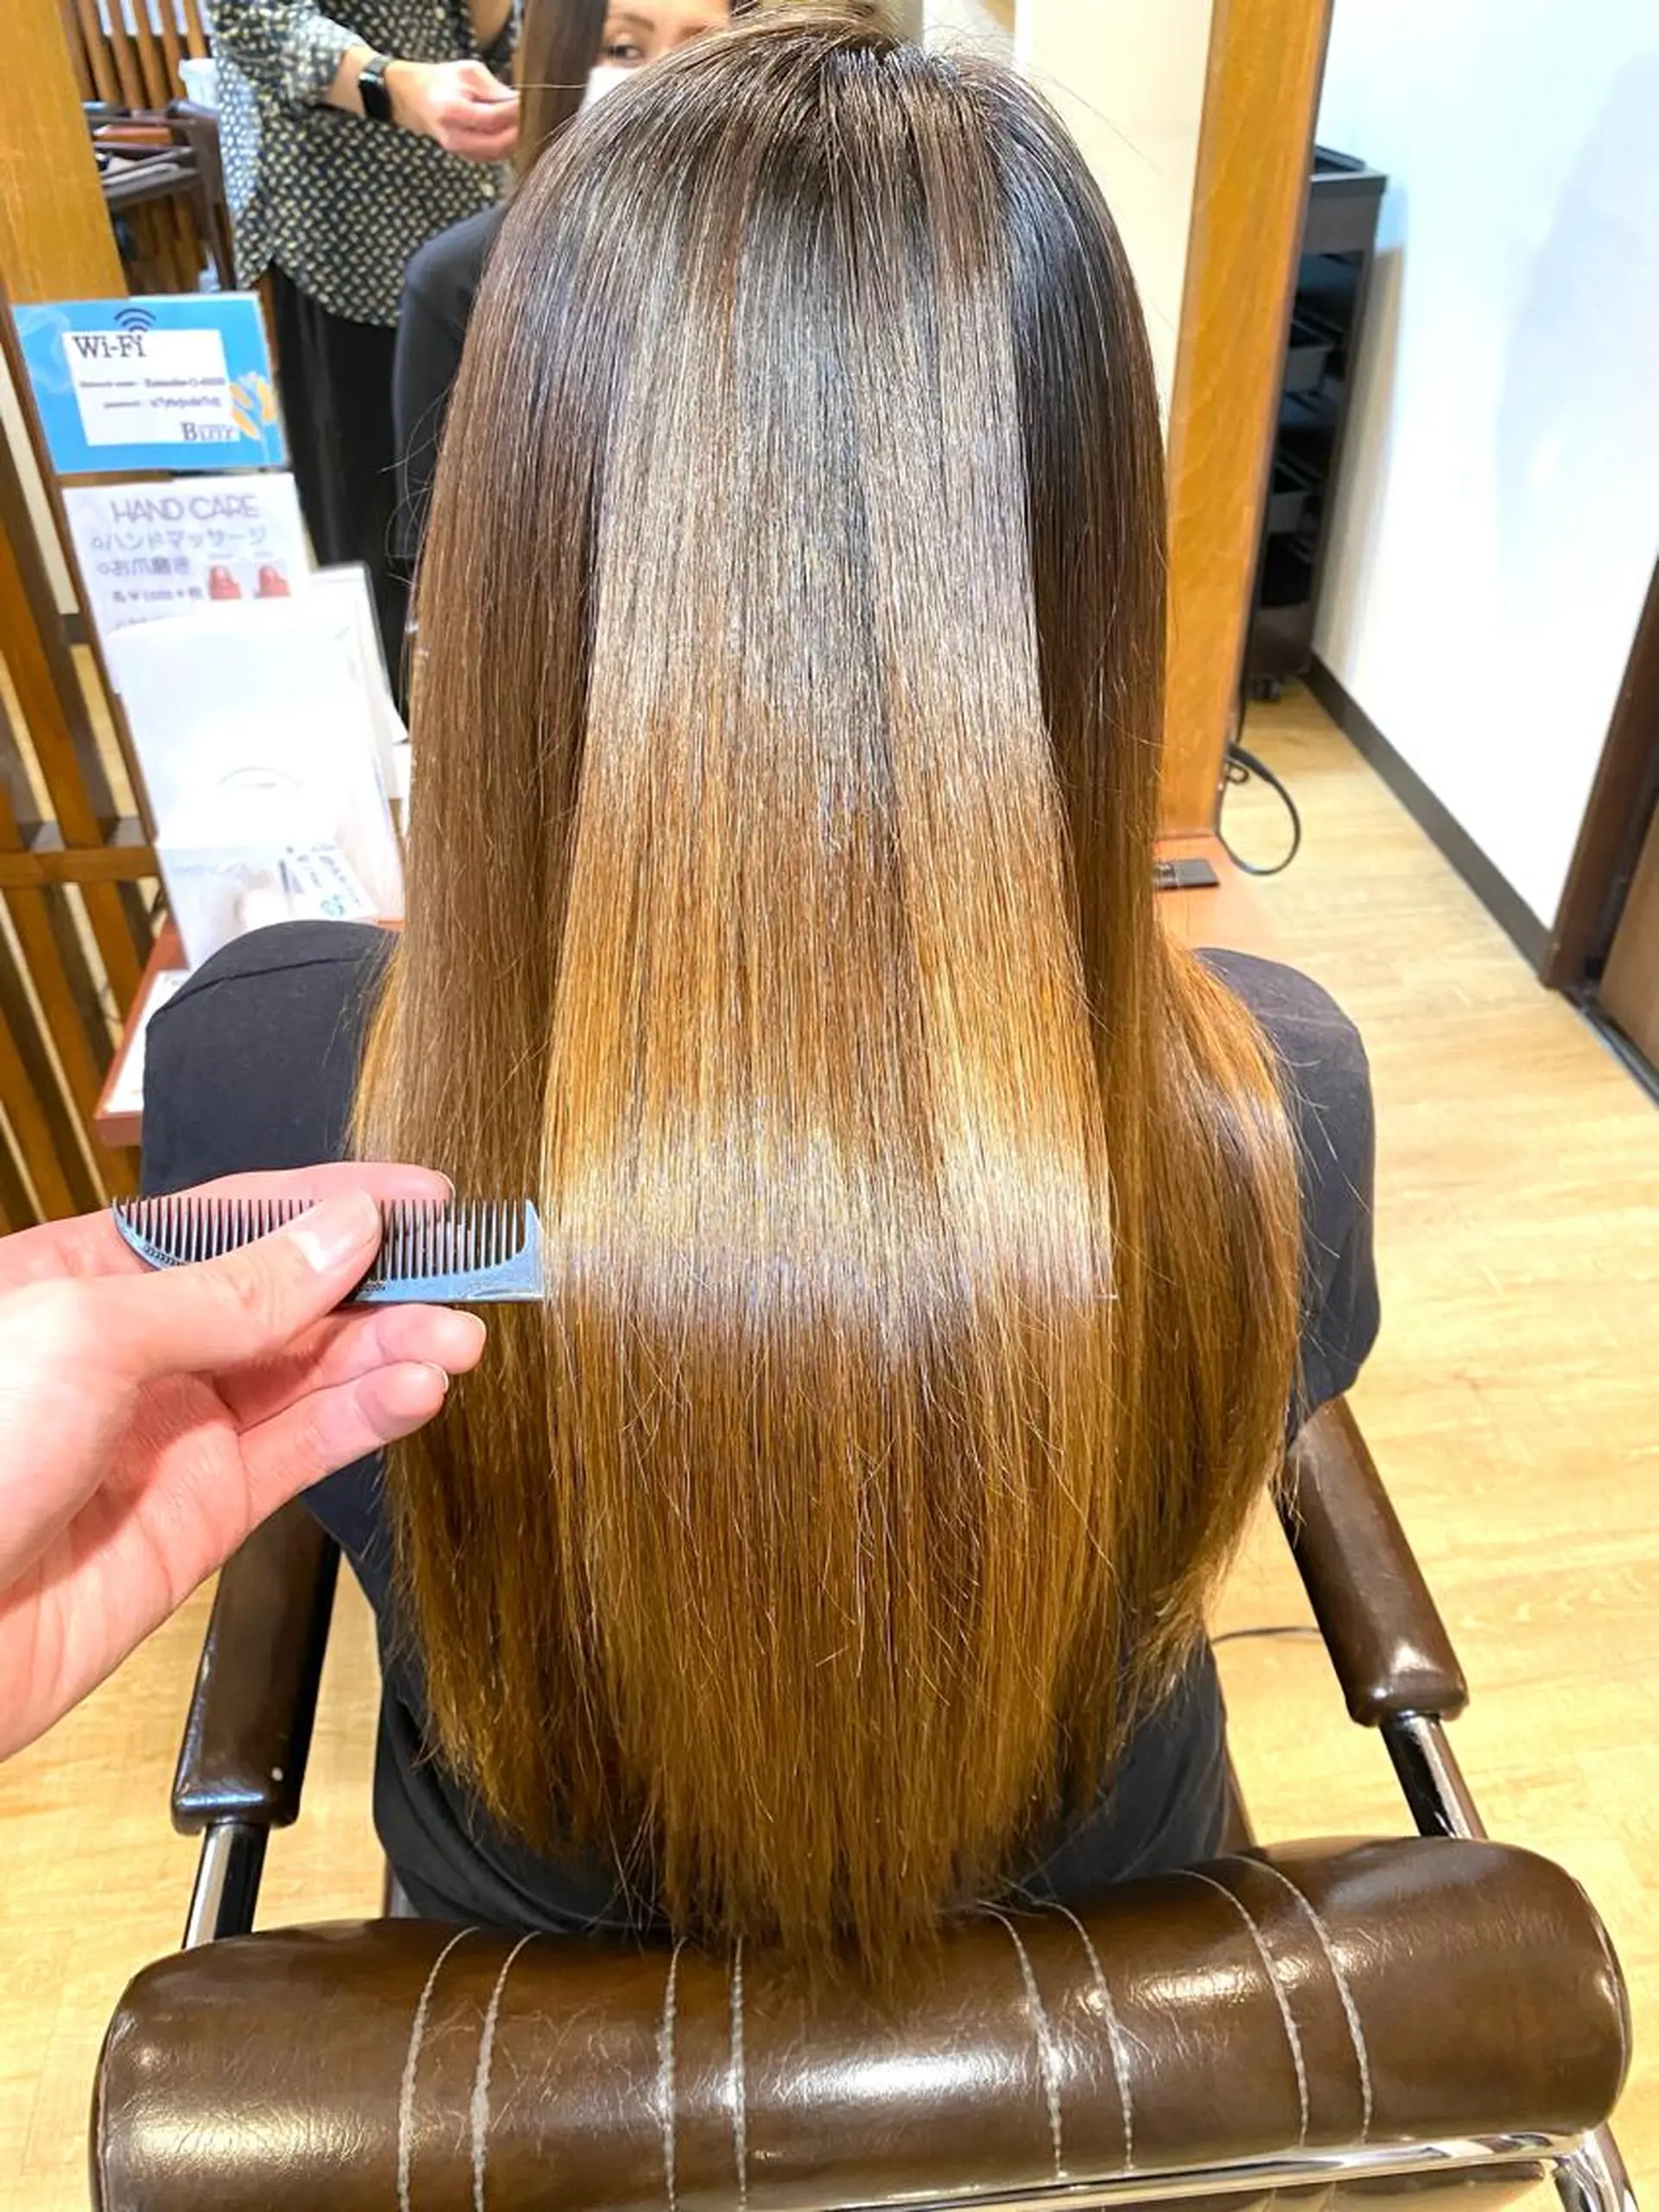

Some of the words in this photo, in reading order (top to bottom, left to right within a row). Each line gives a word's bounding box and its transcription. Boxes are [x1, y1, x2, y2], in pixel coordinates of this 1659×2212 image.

[72, 334, 147, 359] Wi-Fi
[110, 498, 185, 524] HAND
[188, 494, 261, 520] CARE
